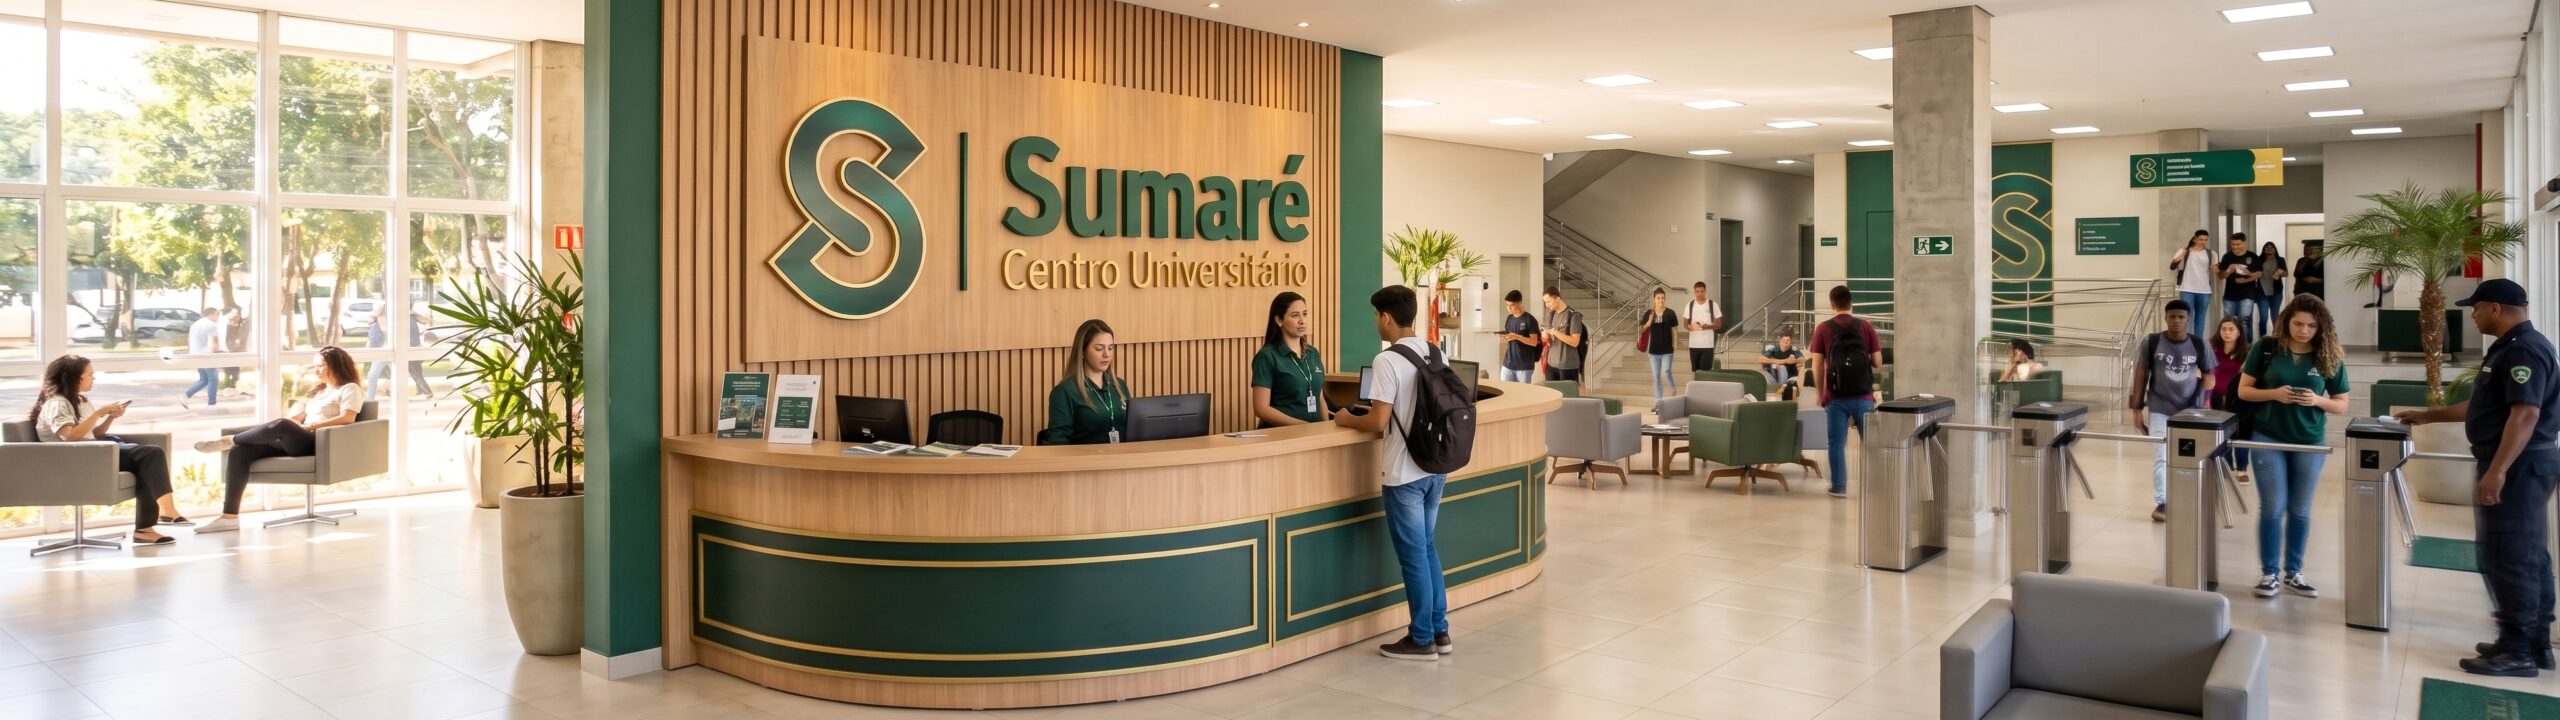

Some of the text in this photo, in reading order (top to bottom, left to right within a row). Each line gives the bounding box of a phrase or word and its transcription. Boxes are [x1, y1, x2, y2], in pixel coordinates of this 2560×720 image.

[1001, 136, 1310, 242] Sumaré
[1001, 248, 1309, 290] Centro Universitário
